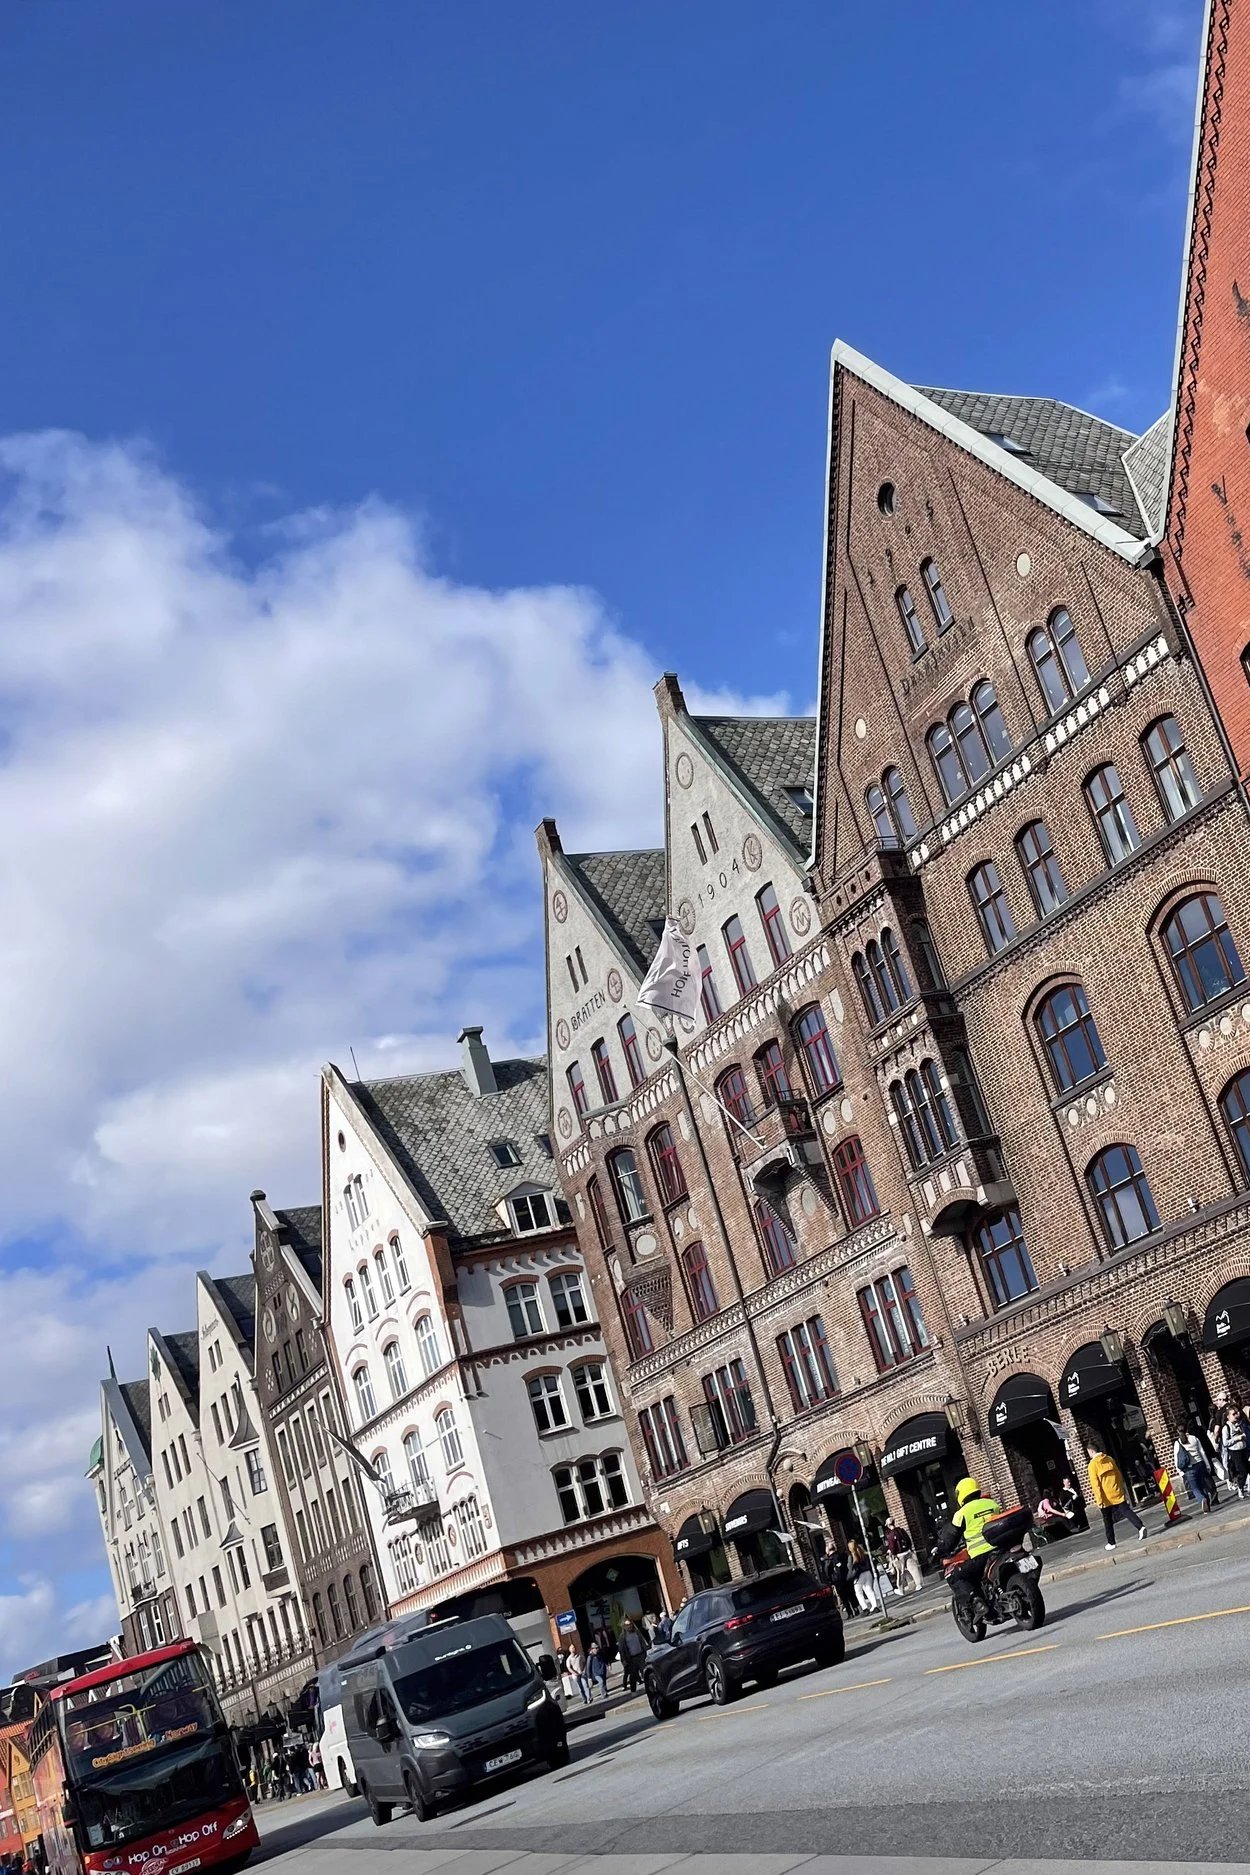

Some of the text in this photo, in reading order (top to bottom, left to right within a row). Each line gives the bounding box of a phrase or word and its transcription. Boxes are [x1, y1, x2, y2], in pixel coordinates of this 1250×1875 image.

[698, 859, 740, 908] 1904
[987, 1347, 1030, 1375] BERLE
[896, 1445, 908, 1458] GIFT
[910, 1436, 937, 1453] CENTRE
[165, 1722, 198, 1739] Norway
[128, 1821, 218, 1864] Hop On Hop Off
